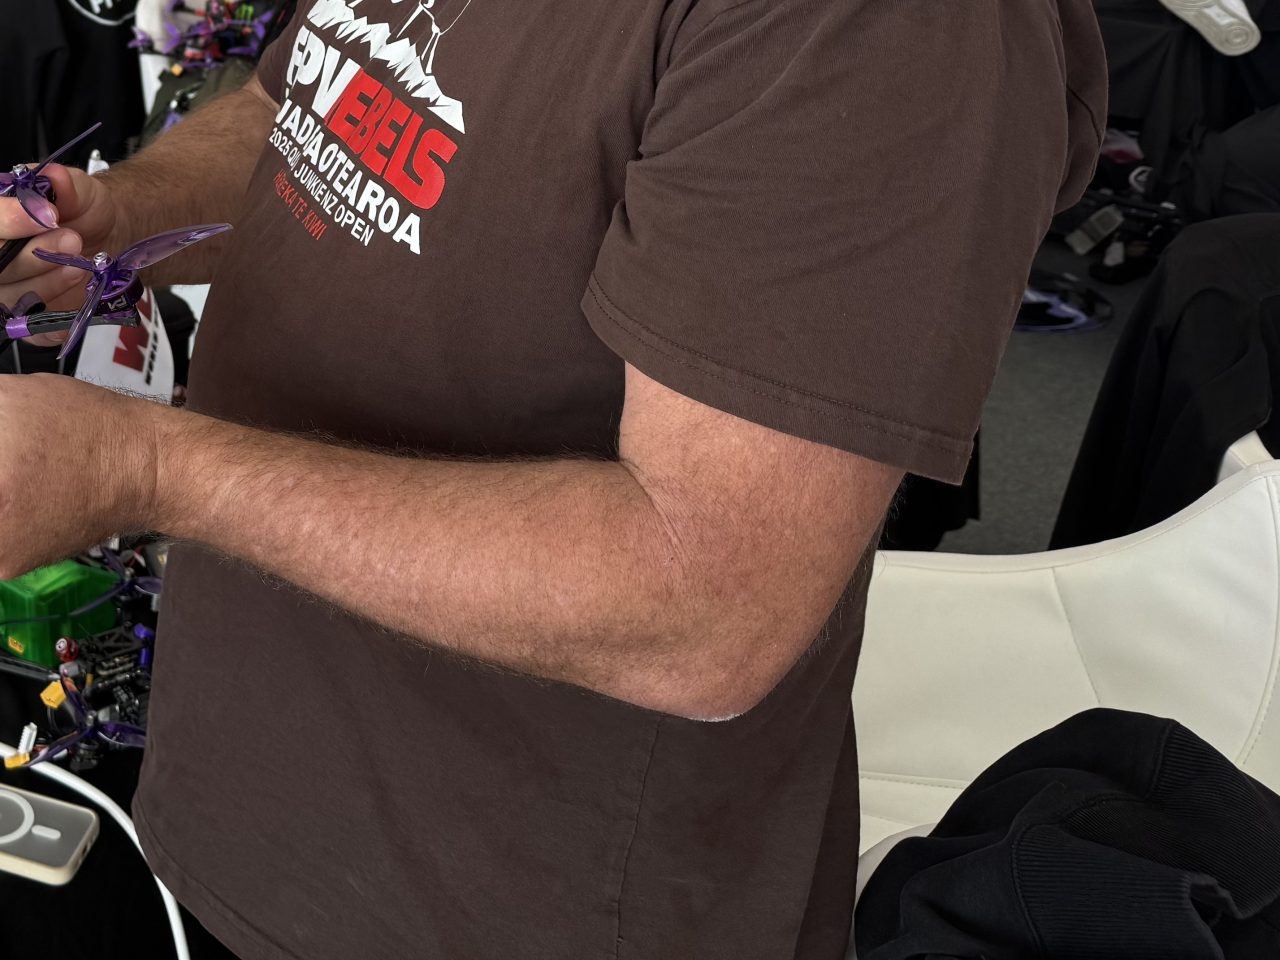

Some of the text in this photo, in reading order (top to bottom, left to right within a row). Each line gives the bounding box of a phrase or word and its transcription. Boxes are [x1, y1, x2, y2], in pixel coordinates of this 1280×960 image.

[268, 127, 293, 157] 2025
[294, 163, 327, 202] JUNKIE
[320, 189, 339, 216] NZ
[334, 204, 375, 247] OPEN
[301, 209, 328, 241] KIWI
